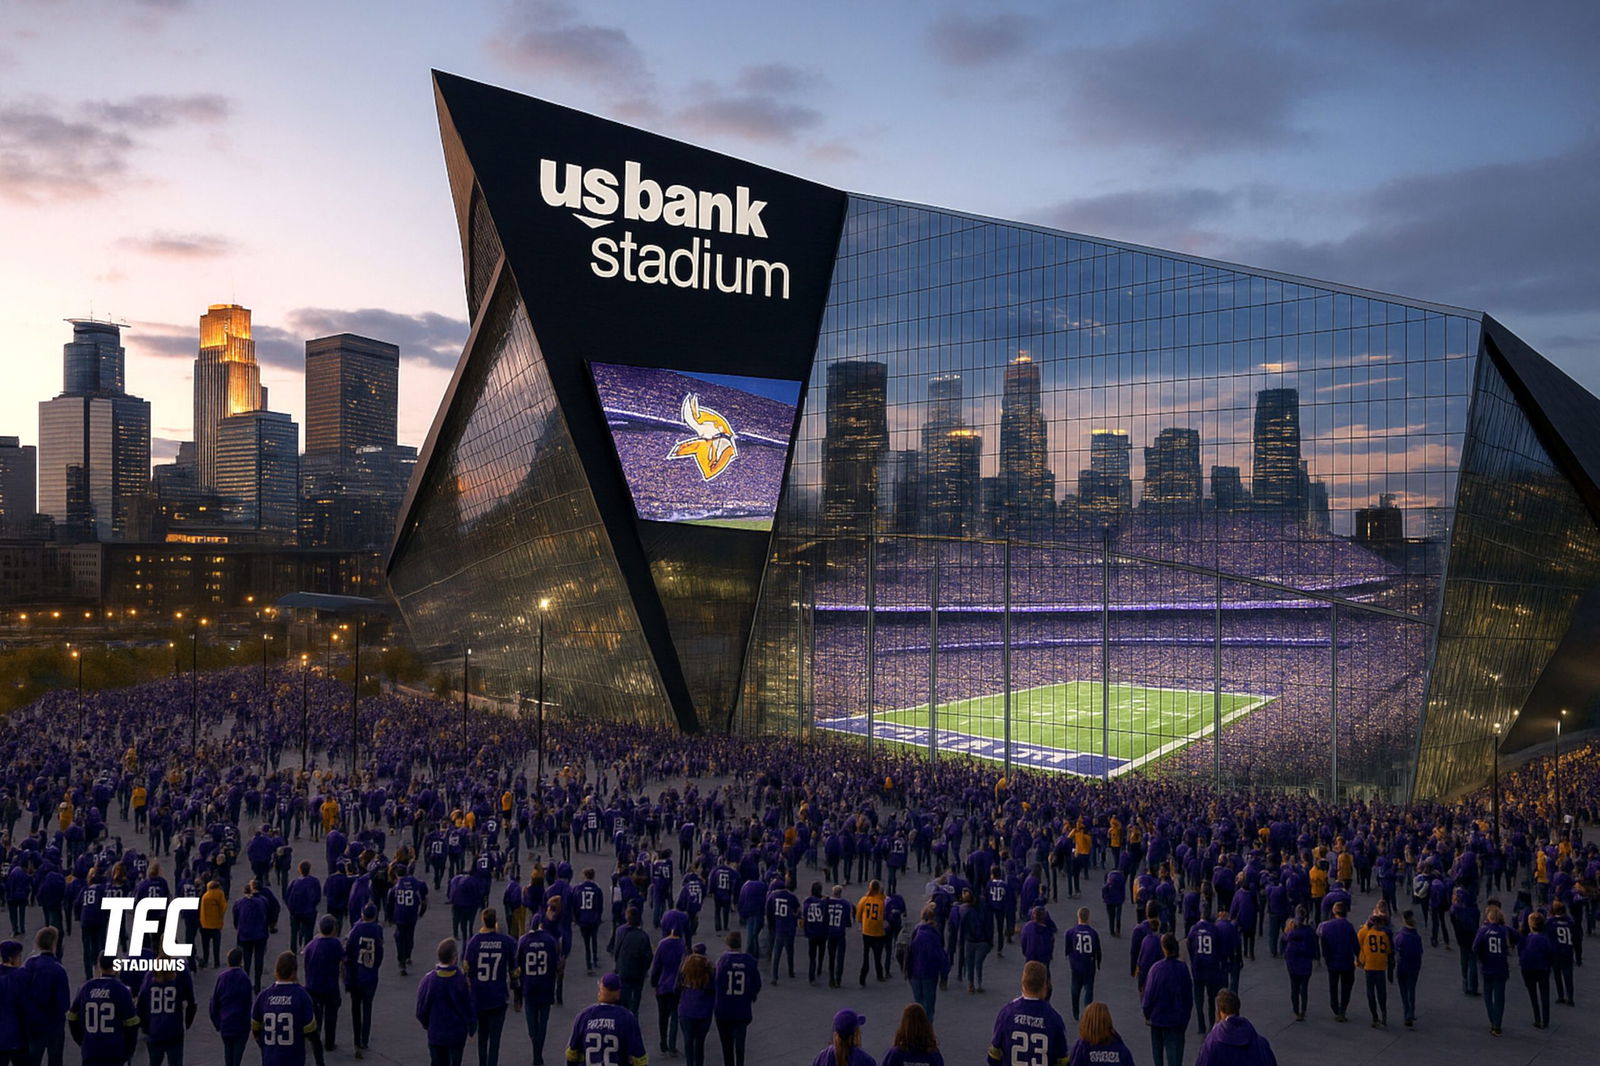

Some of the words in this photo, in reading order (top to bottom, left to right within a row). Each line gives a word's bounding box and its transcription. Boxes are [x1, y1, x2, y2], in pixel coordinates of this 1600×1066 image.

[590, 231, 789, 299] stadium
[477, 953, 501, 981] 57
[726, 971, 745, 995] 13
[85, 1002, 115, 1033] 02
[263, 1012, 294, 1045] 93
[585, 1033, 619, 1066] 22
[1011, 1031, 1049, 1066] 23
